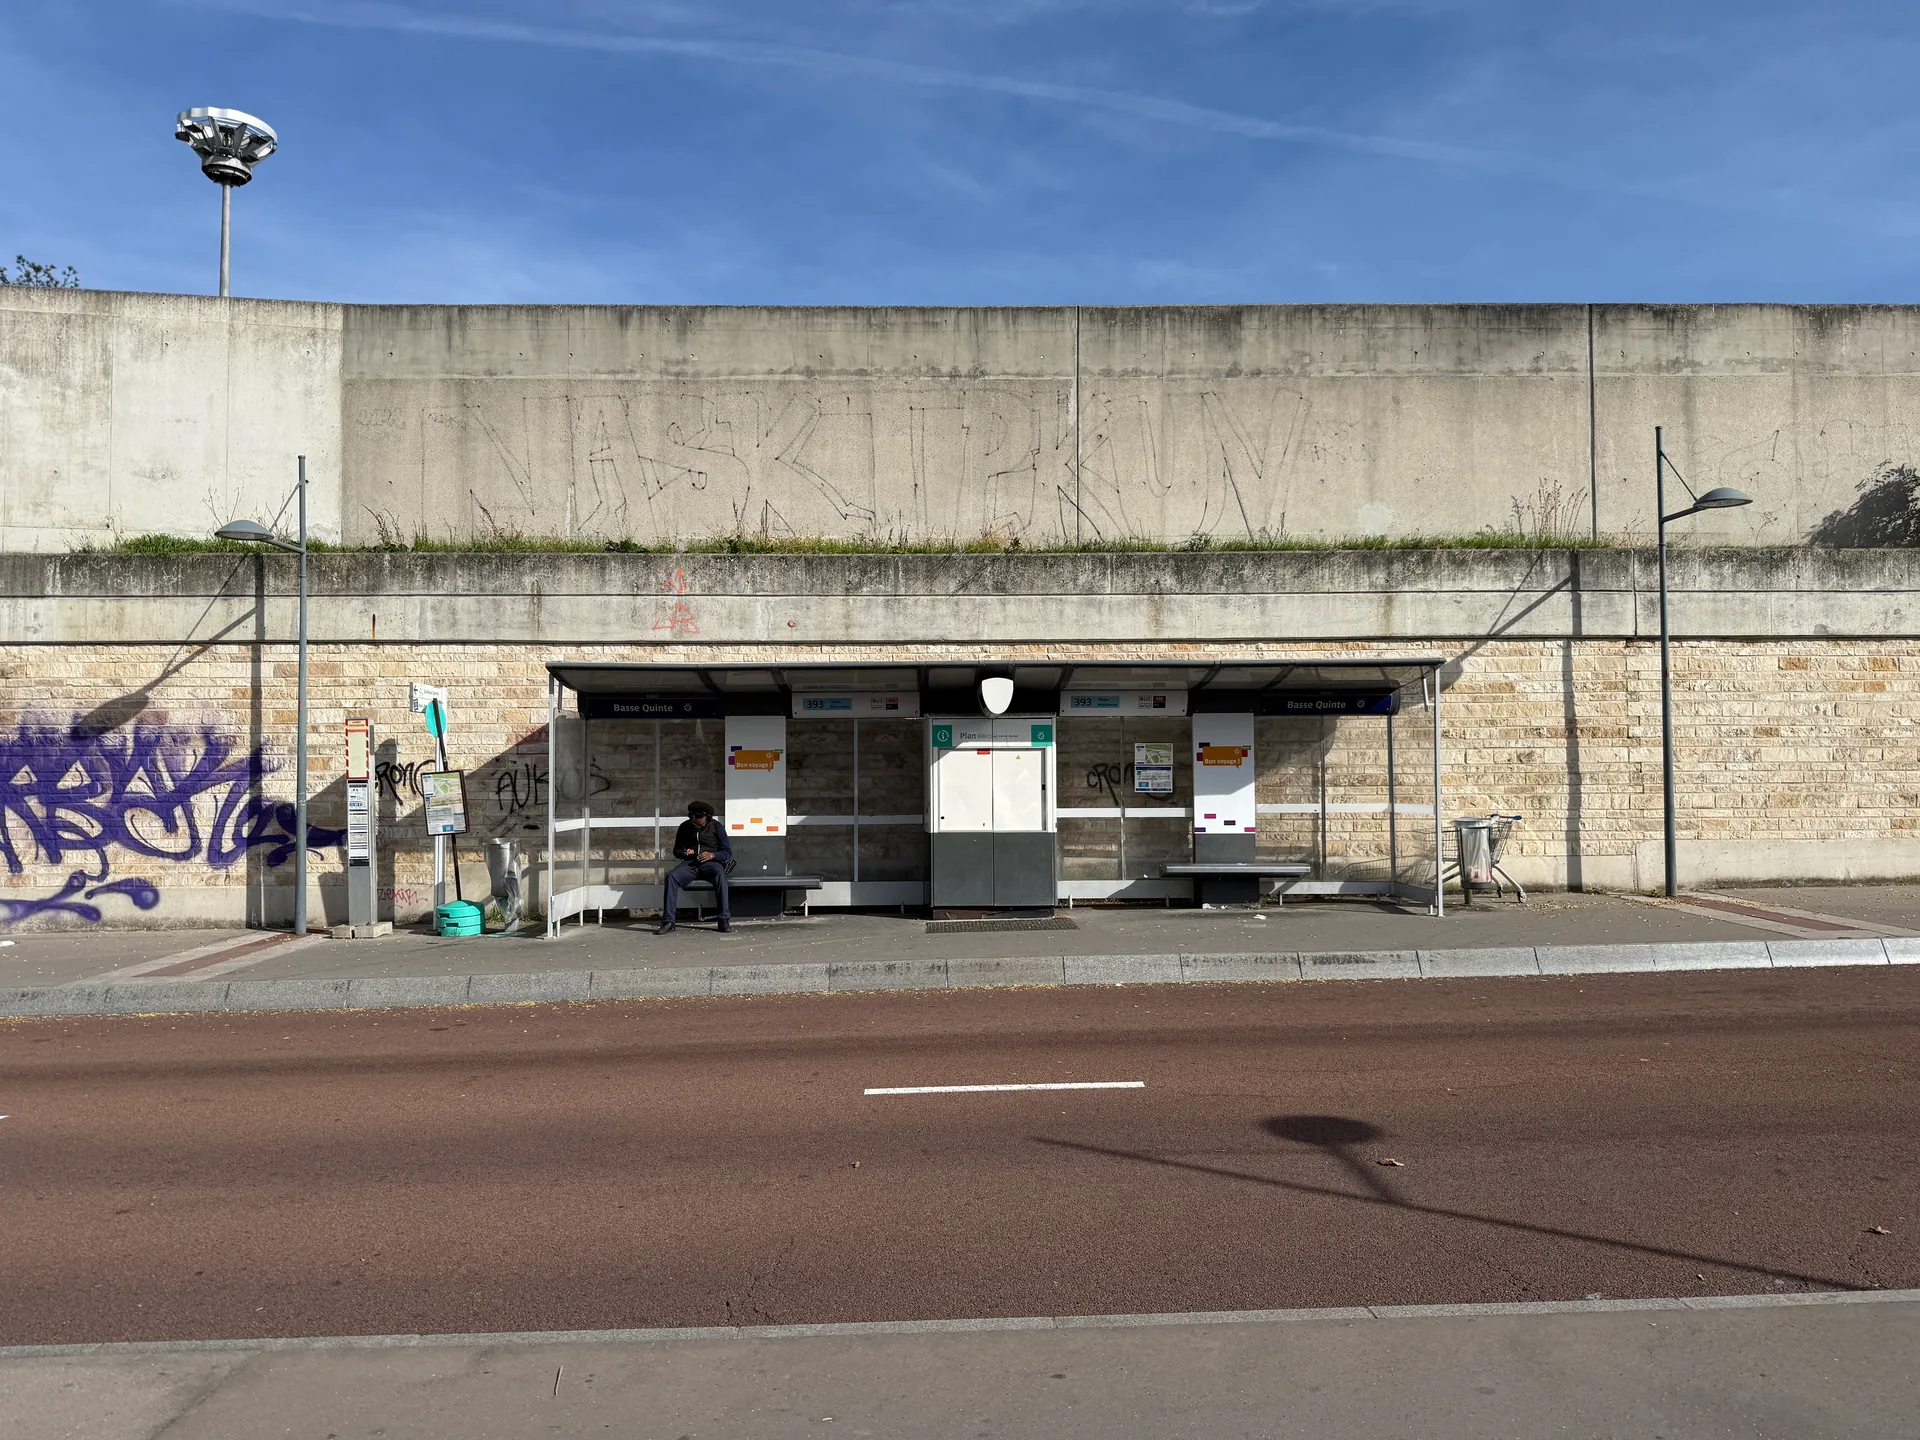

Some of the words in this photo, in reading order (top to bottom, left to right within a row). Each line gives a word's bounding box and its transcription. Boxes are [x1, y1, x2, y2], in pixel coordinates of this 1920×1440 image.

[806, 700, 824, 709] 393
[1074, 697, 1092, 707] 393
[1287, 700, 1313, 709] Basse
[1315, 699, 1346, 710] Quinte
[613, 703, 640, 712] Basse
[642, 702, 673, 713] Quinte
[959, 732, 977, 740] Plan
